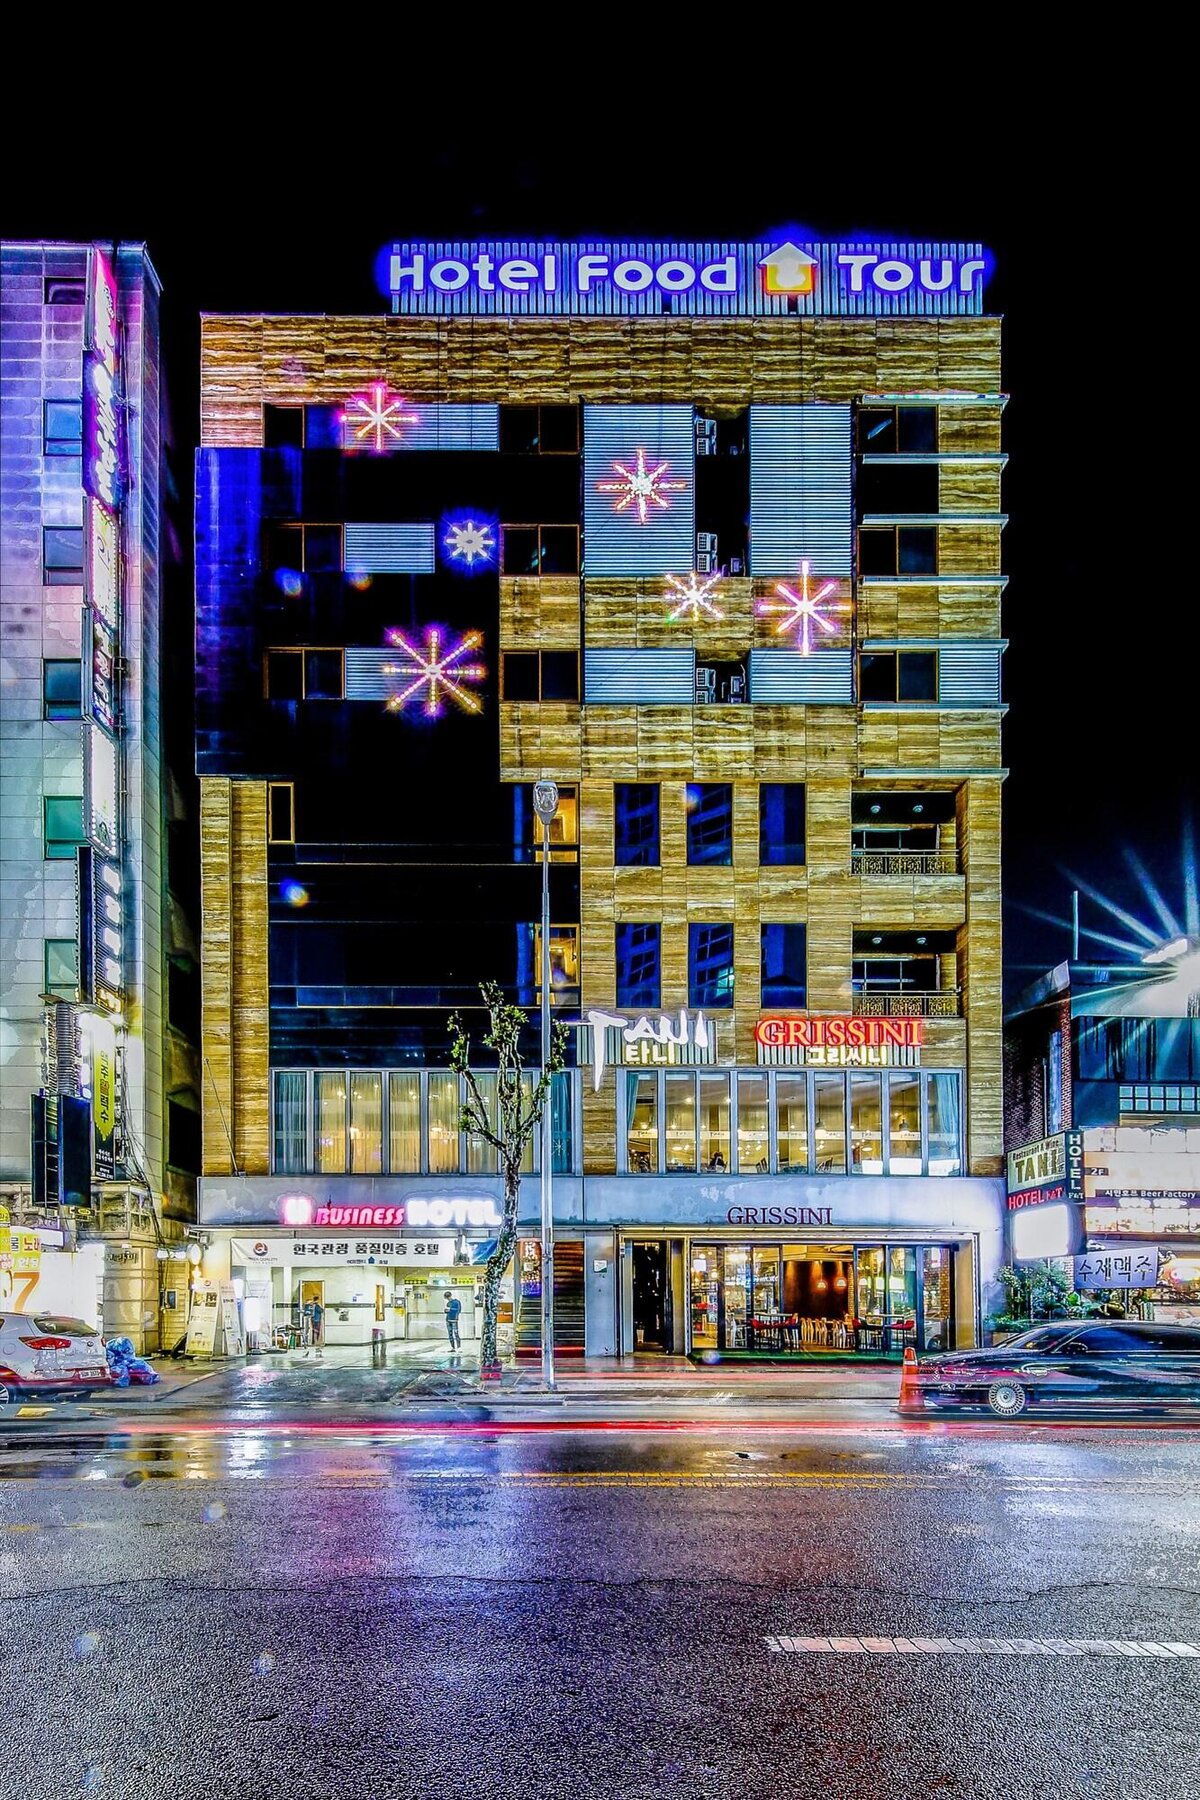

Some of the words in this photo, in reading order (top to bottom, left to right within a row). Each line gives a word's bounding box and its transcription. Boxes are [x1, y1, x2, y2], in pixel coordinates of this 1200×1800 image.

[389, 254, 556, 292] Hotel
[578, 254, 737, 292] Food
[838, 254, 985, 292] Tour
[757, 1018, 922, 1046] GRISSINI
[807, 1045, 888, 1066] 그리씨니
[1069, 1134, 1082, 1190] HOTEL
[1008, 1190, 1045, 1210] HOTEL
[1140, 1189, 1161, 1197] Beer
[1163, 1190, 1196, 1199] Factory
[315, 1207, 405, 1225] BUSINESS
[407, 1198, 502, 1226] HOTEL
[727, 1206, 833, 1225] GRISSINI
[293, 1242, 349, 1256] 한국관광
[355, 1242, 408, 1256] 품질인증
[413, 1242, 440, 1256] 호텔
[1078, 1255, 1153, 1282] 수제맥주
